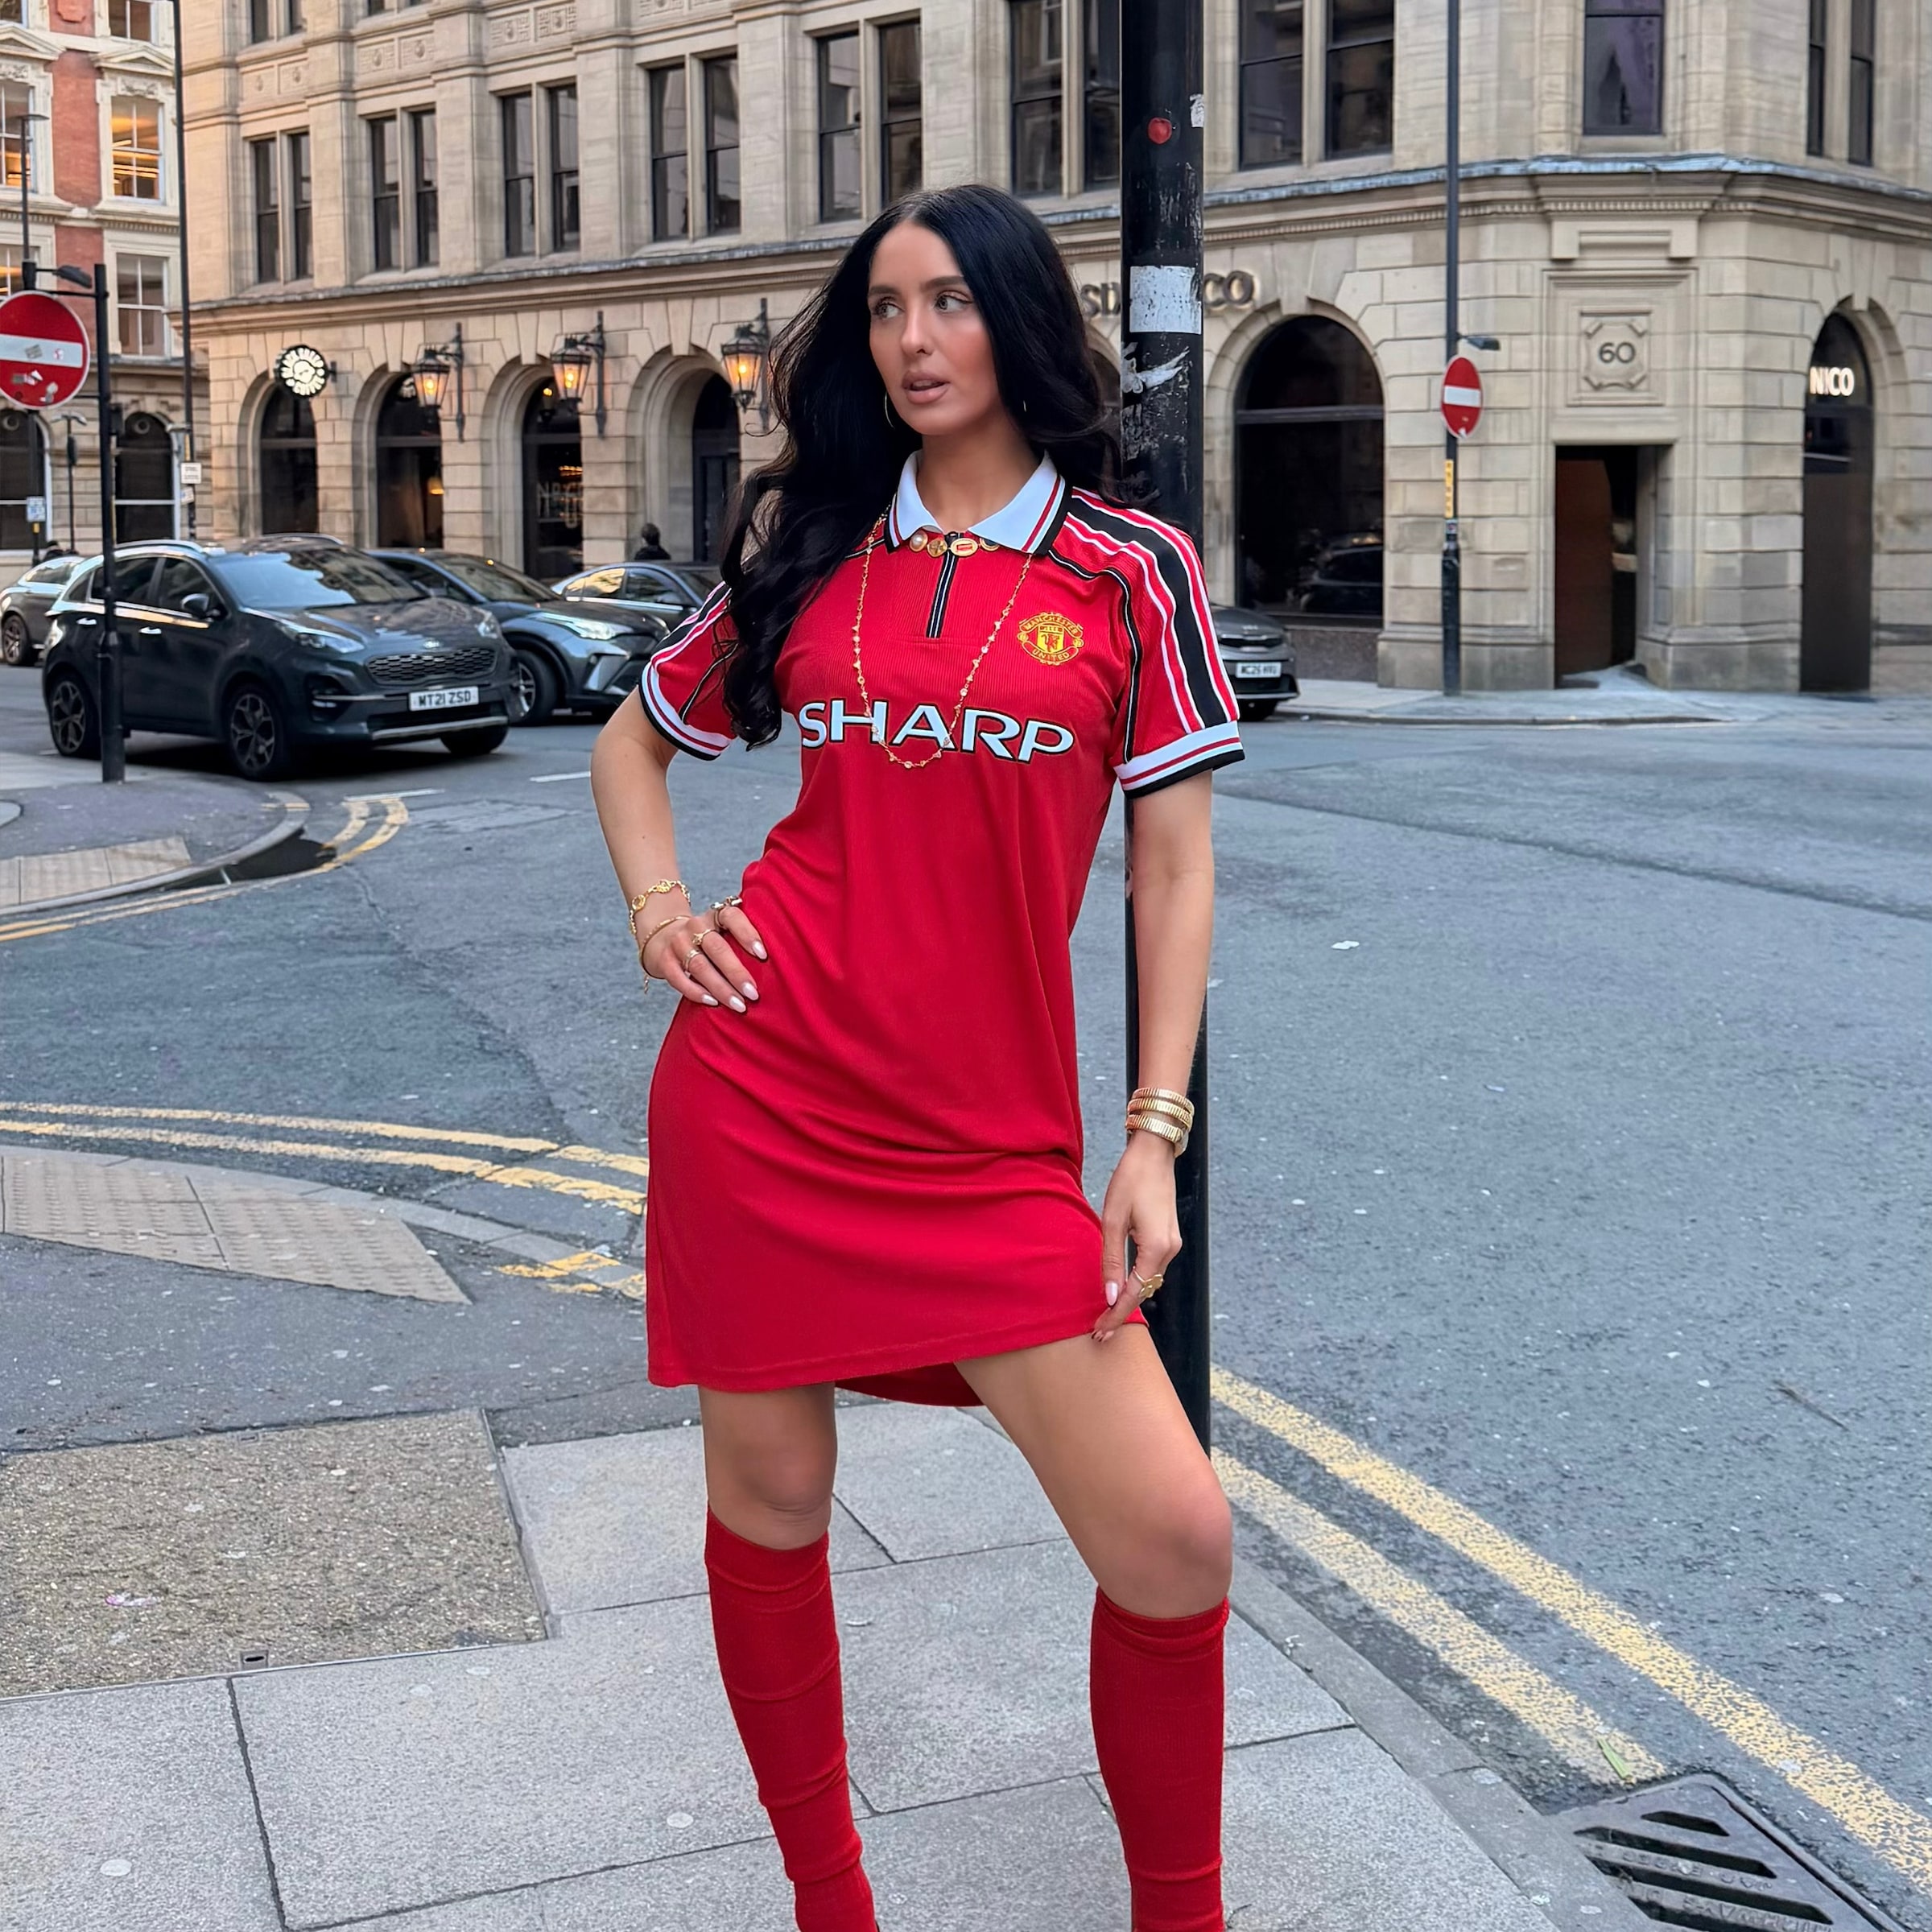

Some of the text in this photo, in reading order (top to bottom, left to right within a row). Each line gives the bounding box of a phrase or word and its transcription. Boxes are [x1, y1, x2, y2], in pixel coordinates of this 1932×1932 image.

[1599, 341, 1636, 364] 60
[1810, 366, 1855, 396] NICO
[1023, 614, 1079, 634] MANCHESTER
[1031, 648, 1070, 661] UNITED
[798, 698, 1075, 764] SHARP
